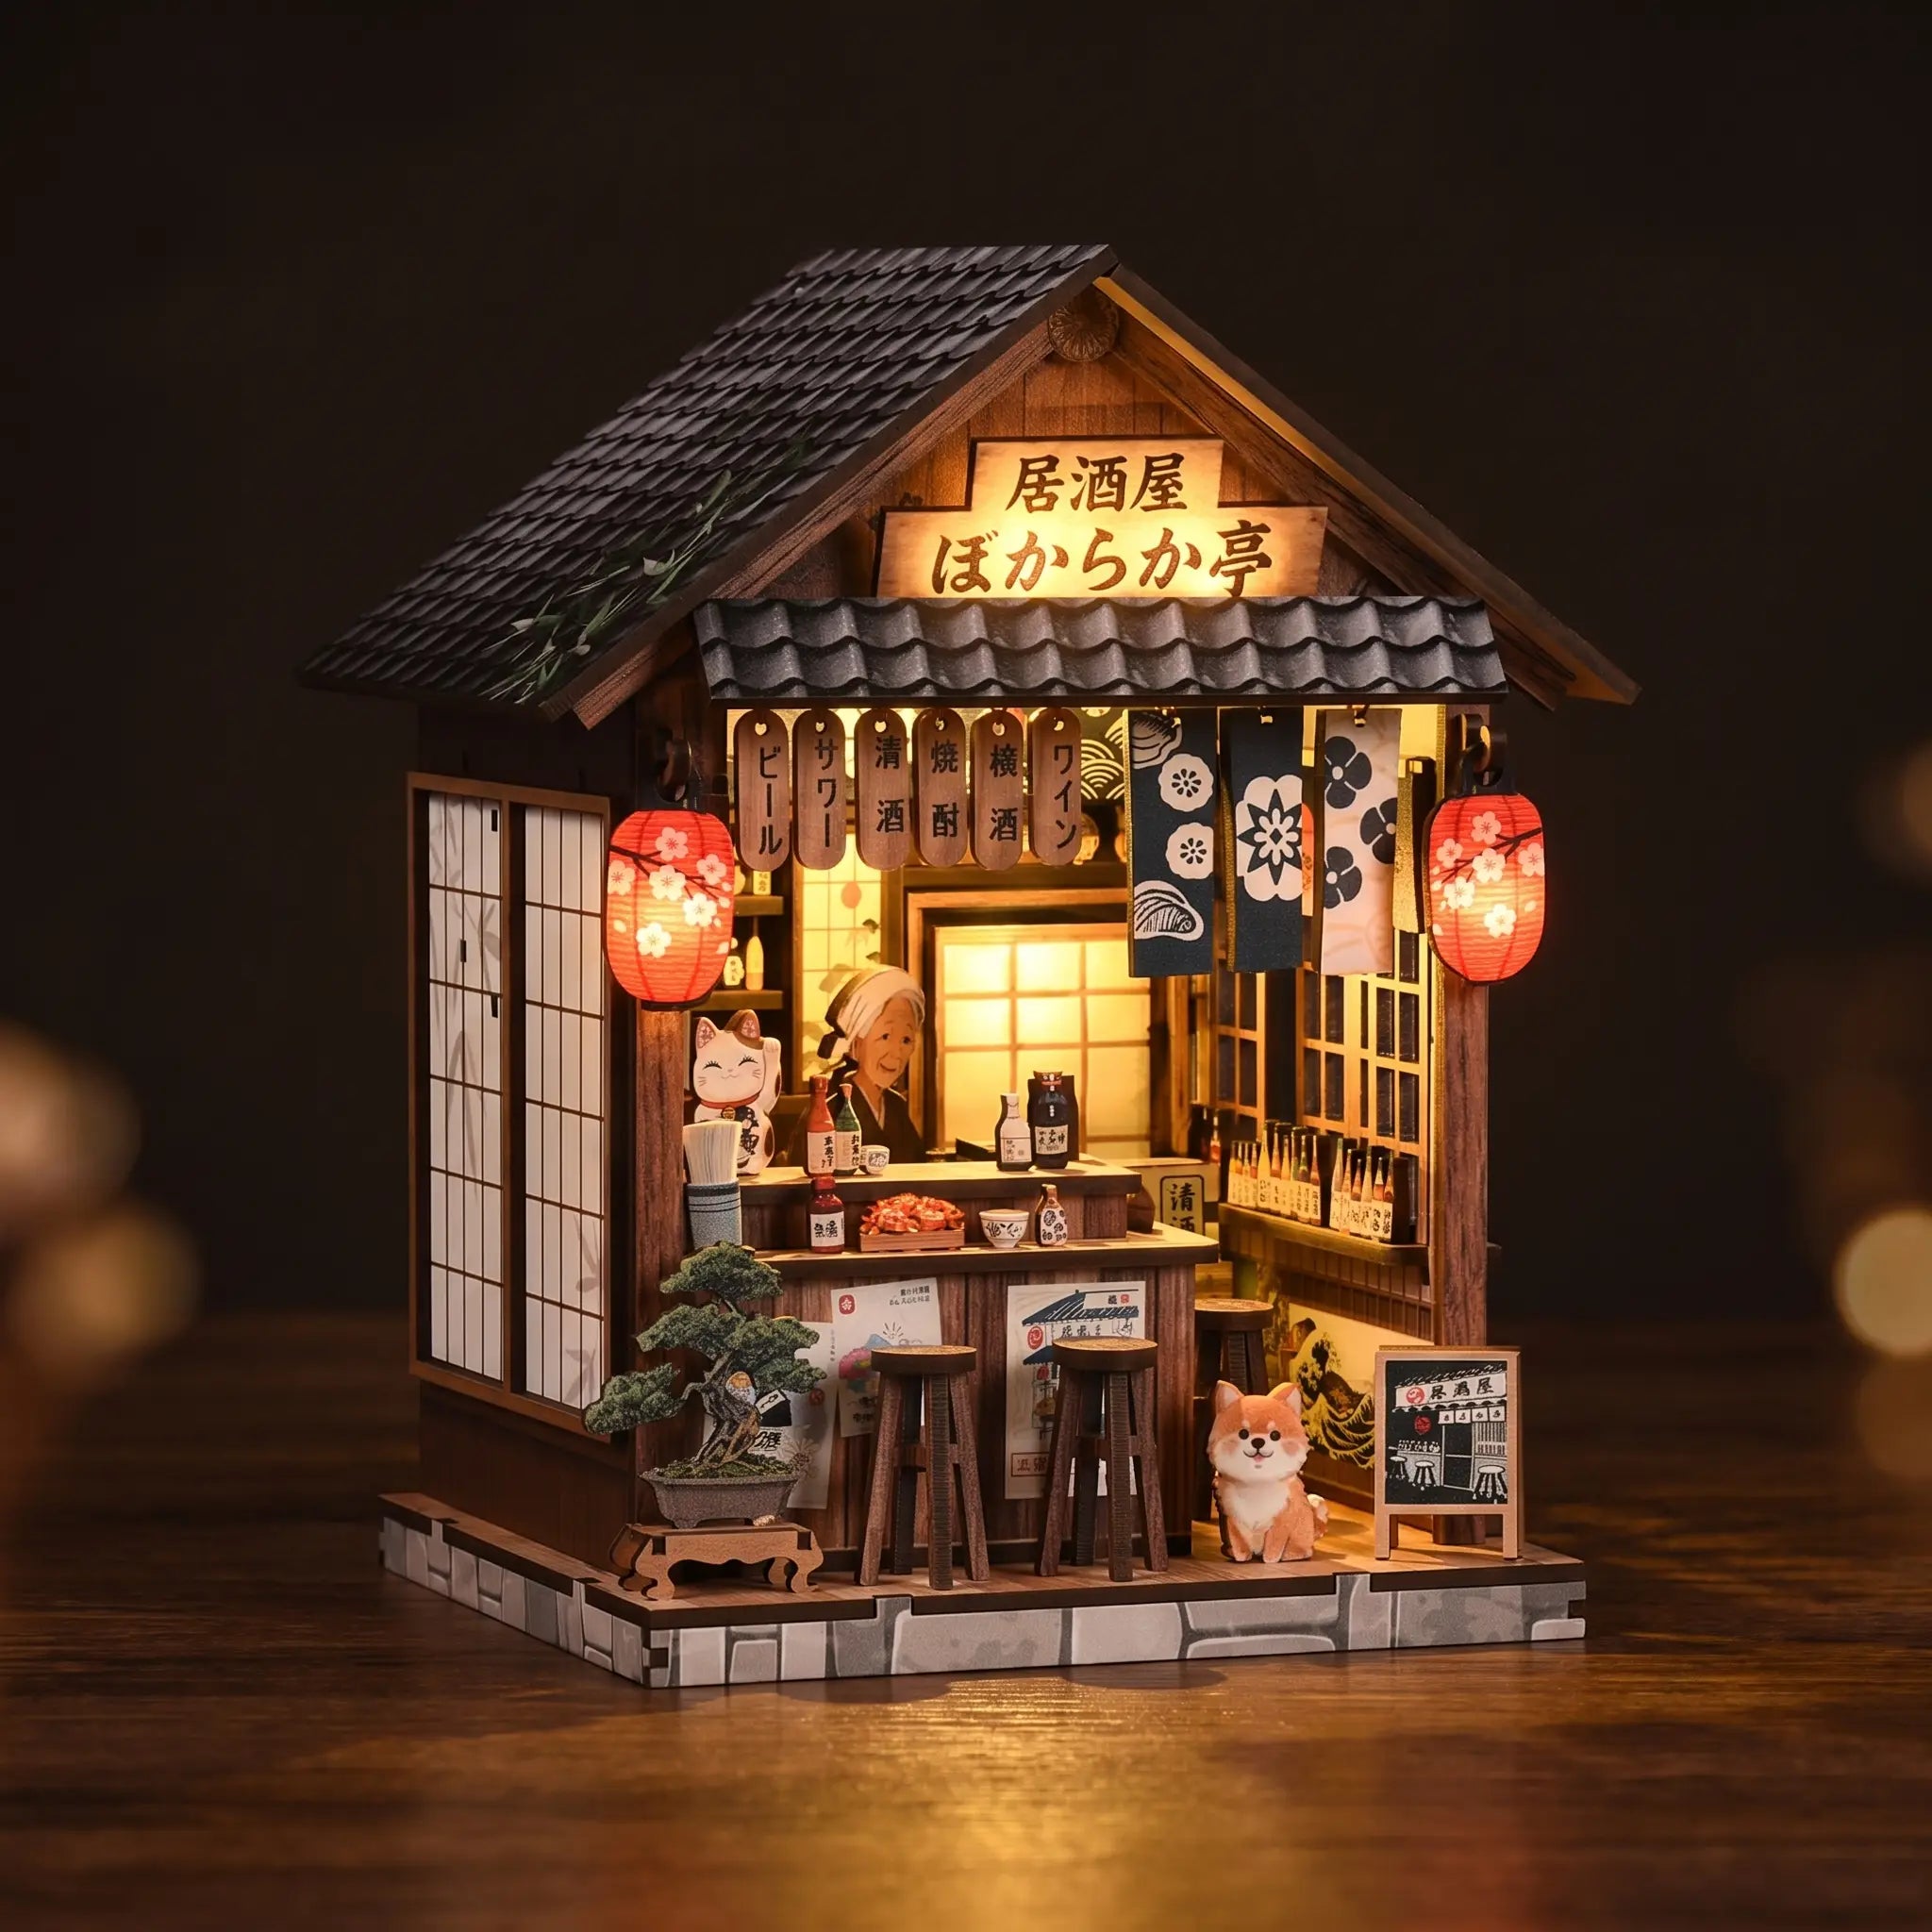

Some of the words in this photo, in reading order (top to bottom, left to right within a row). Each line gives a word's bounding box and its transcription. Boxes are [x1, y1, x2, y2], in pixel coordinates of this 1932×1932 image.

[1006, 453, 1189, 513] 居酒屋
[931, 519, 1274, 597] ぼからか亭
[758, 744, 783, 856] ビール
[814, 739, 839, 848] サワー
[874, 734, 906, 834] 清酒
[930, 739, 960, 838] 焼酎
[1052, 743, 1077, 850] ワイン
